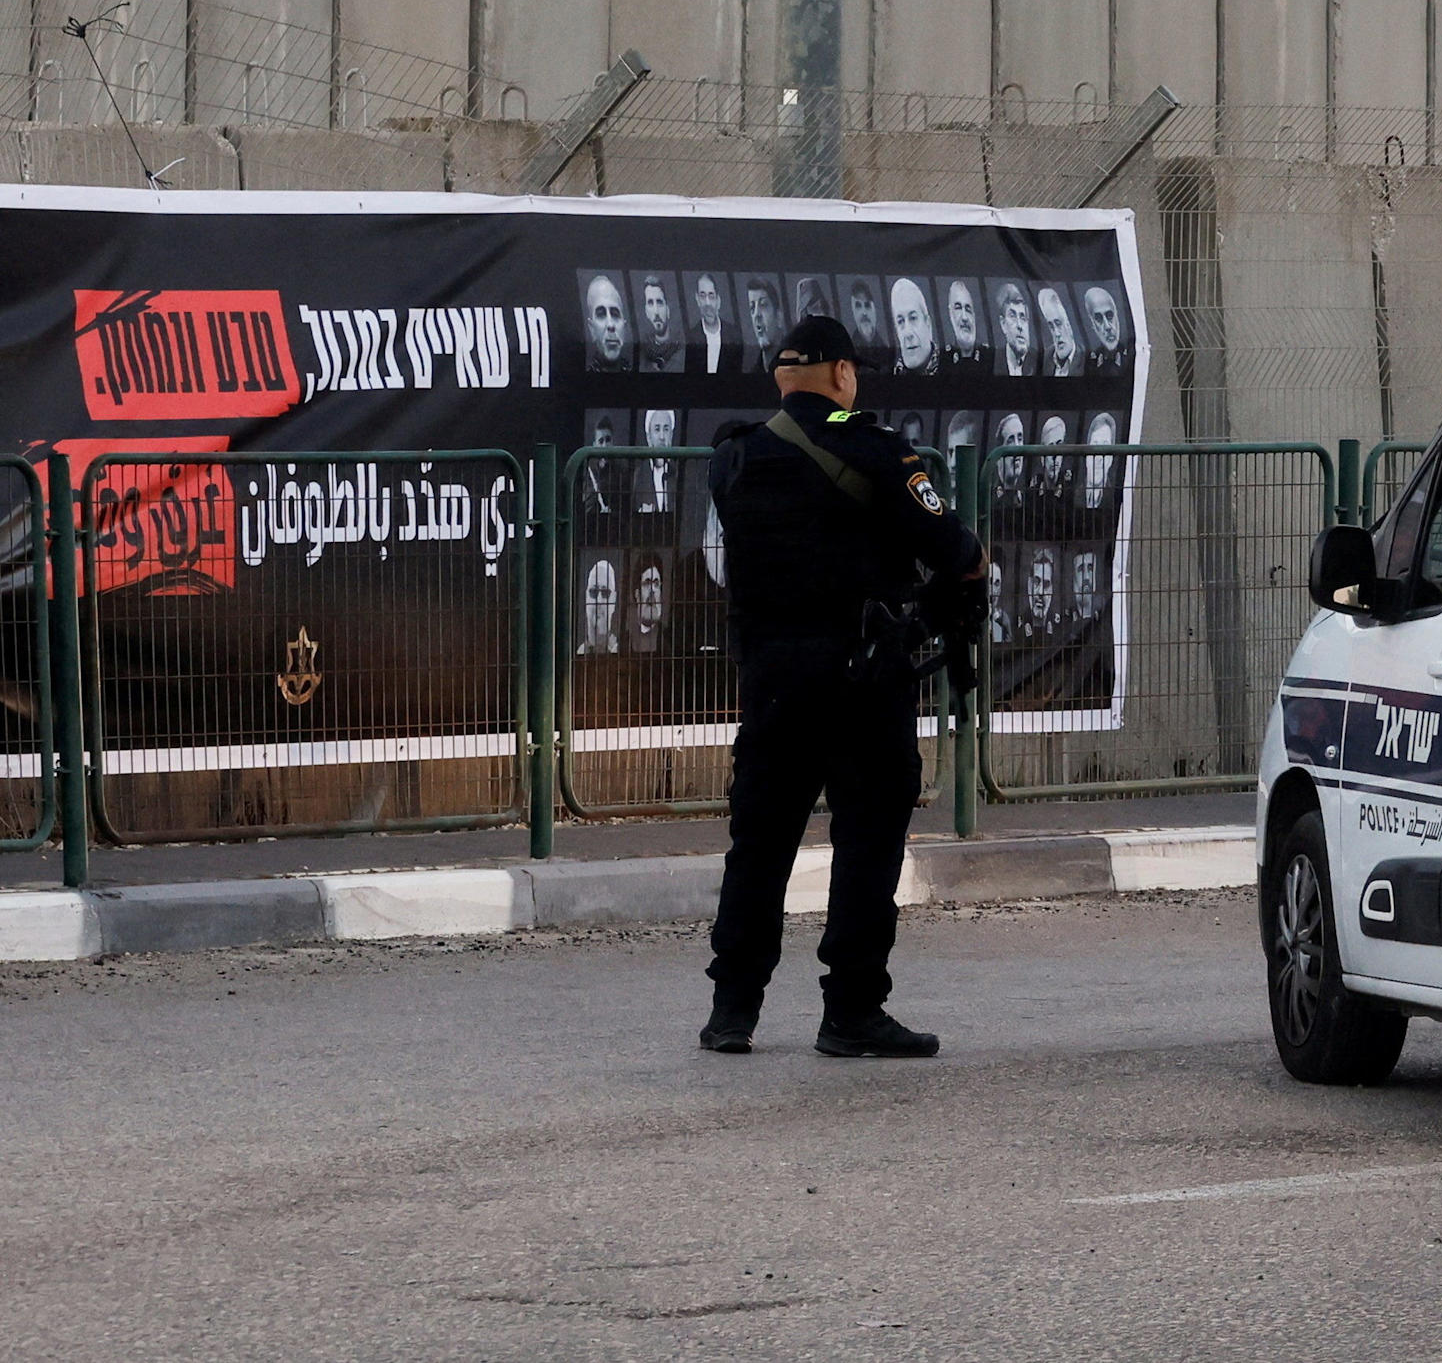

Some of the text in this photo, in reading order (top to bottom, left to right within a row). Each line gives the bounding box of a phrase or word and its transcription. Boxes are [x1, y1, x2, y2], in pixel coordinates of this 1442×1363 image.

[206, 311, 287, 393] טבע
[299, 304, 550, 404] מי שאיים במבול,
[1374, 697, 1441, 765] ישראל
[1360, 803, 1399, 835] POLICE
